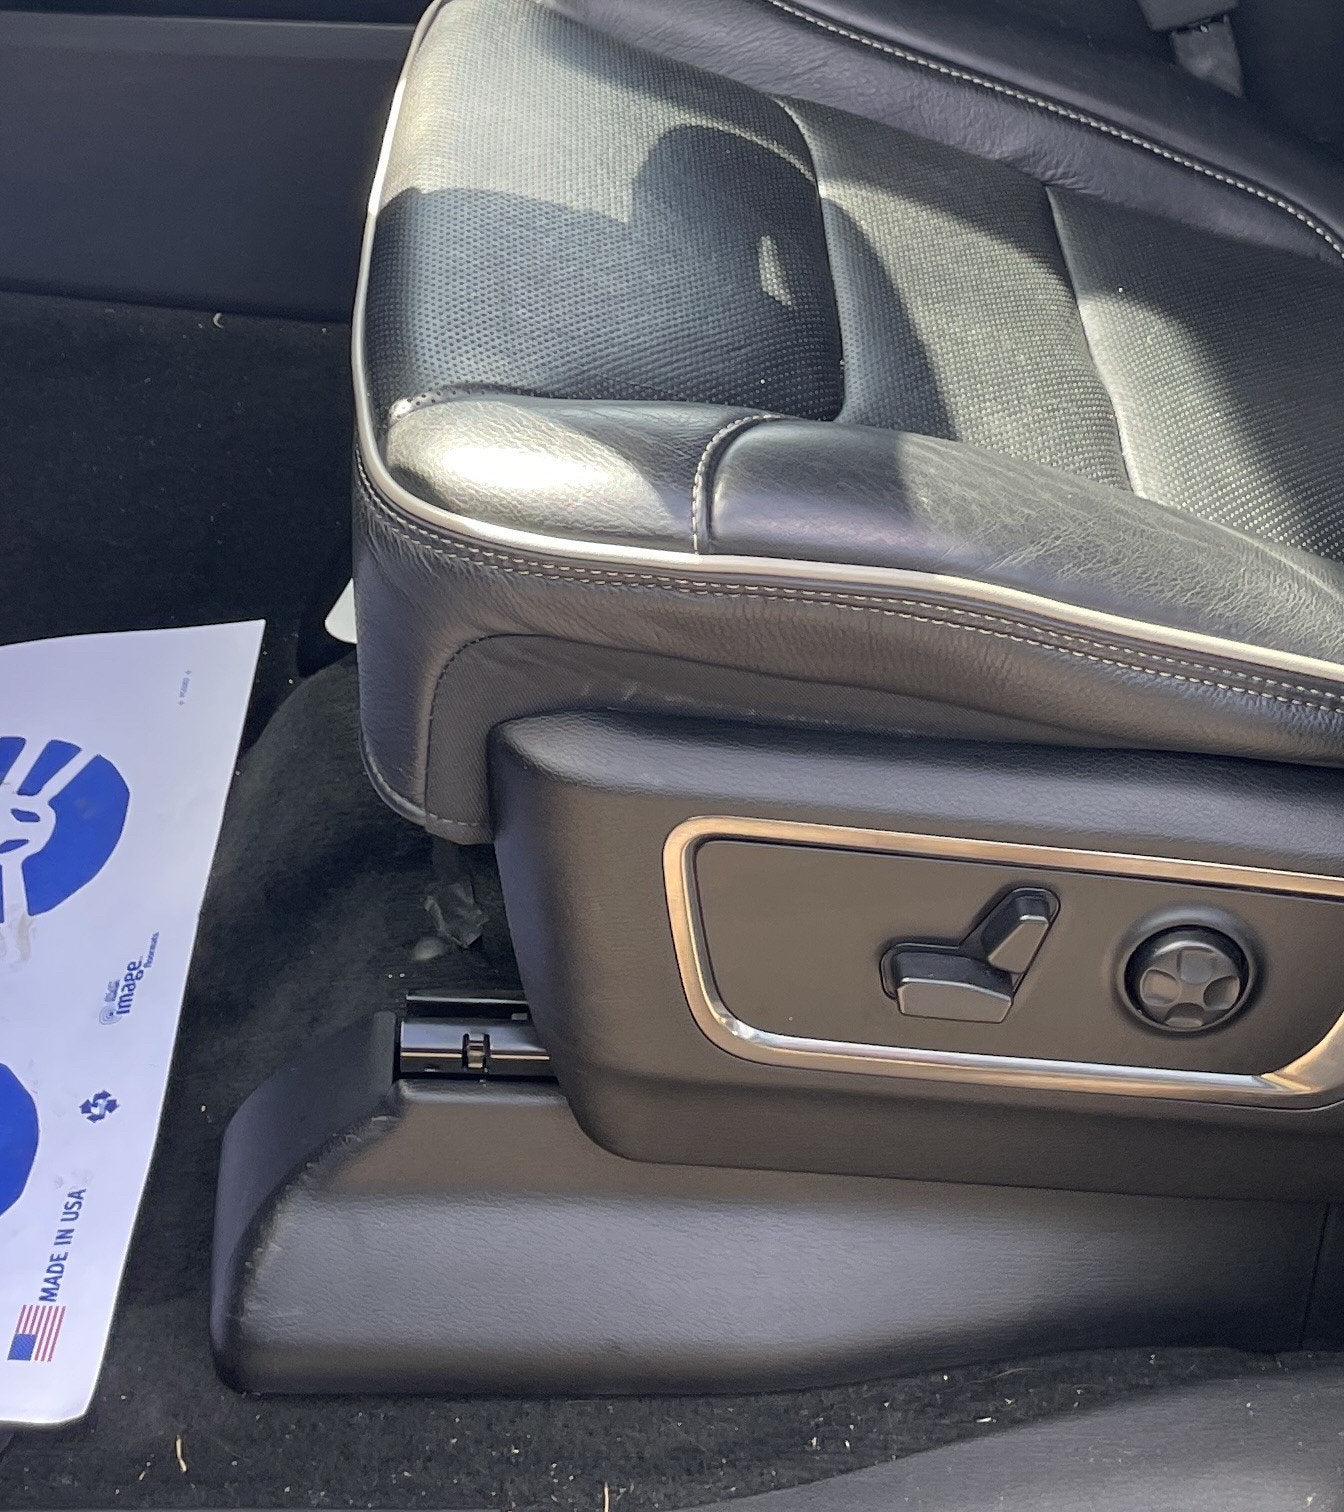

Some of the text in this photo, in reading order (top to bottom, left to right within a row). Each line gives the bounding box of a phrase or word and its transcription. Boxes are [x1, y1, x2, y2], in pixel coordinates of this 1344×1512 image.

[116, 961, 144, 1015] image
[38, 1188, 87, 1302] MADE IN USA
